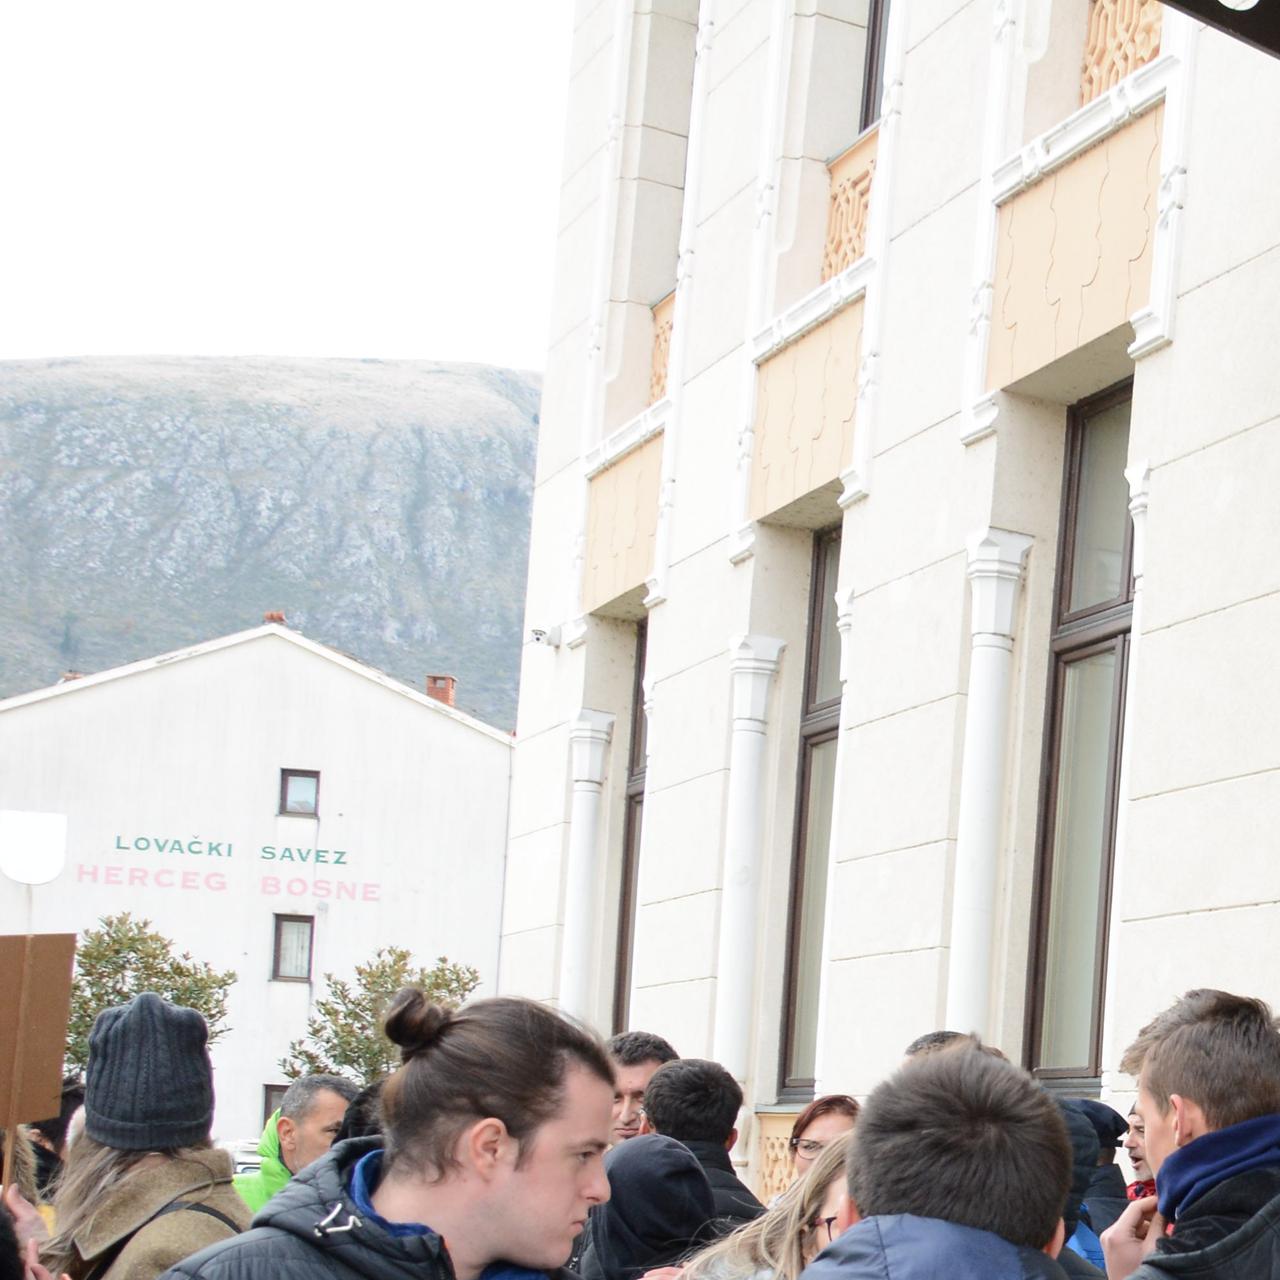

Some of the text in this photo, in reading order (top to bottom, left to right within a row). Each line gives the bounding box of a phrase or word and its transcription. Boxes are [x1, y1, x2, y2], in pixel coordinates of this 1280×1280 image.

[115, 833, 349, 866] LOVAČKI SAVEZ
[76, 863, 382, 902] HERCEG BOSNE
